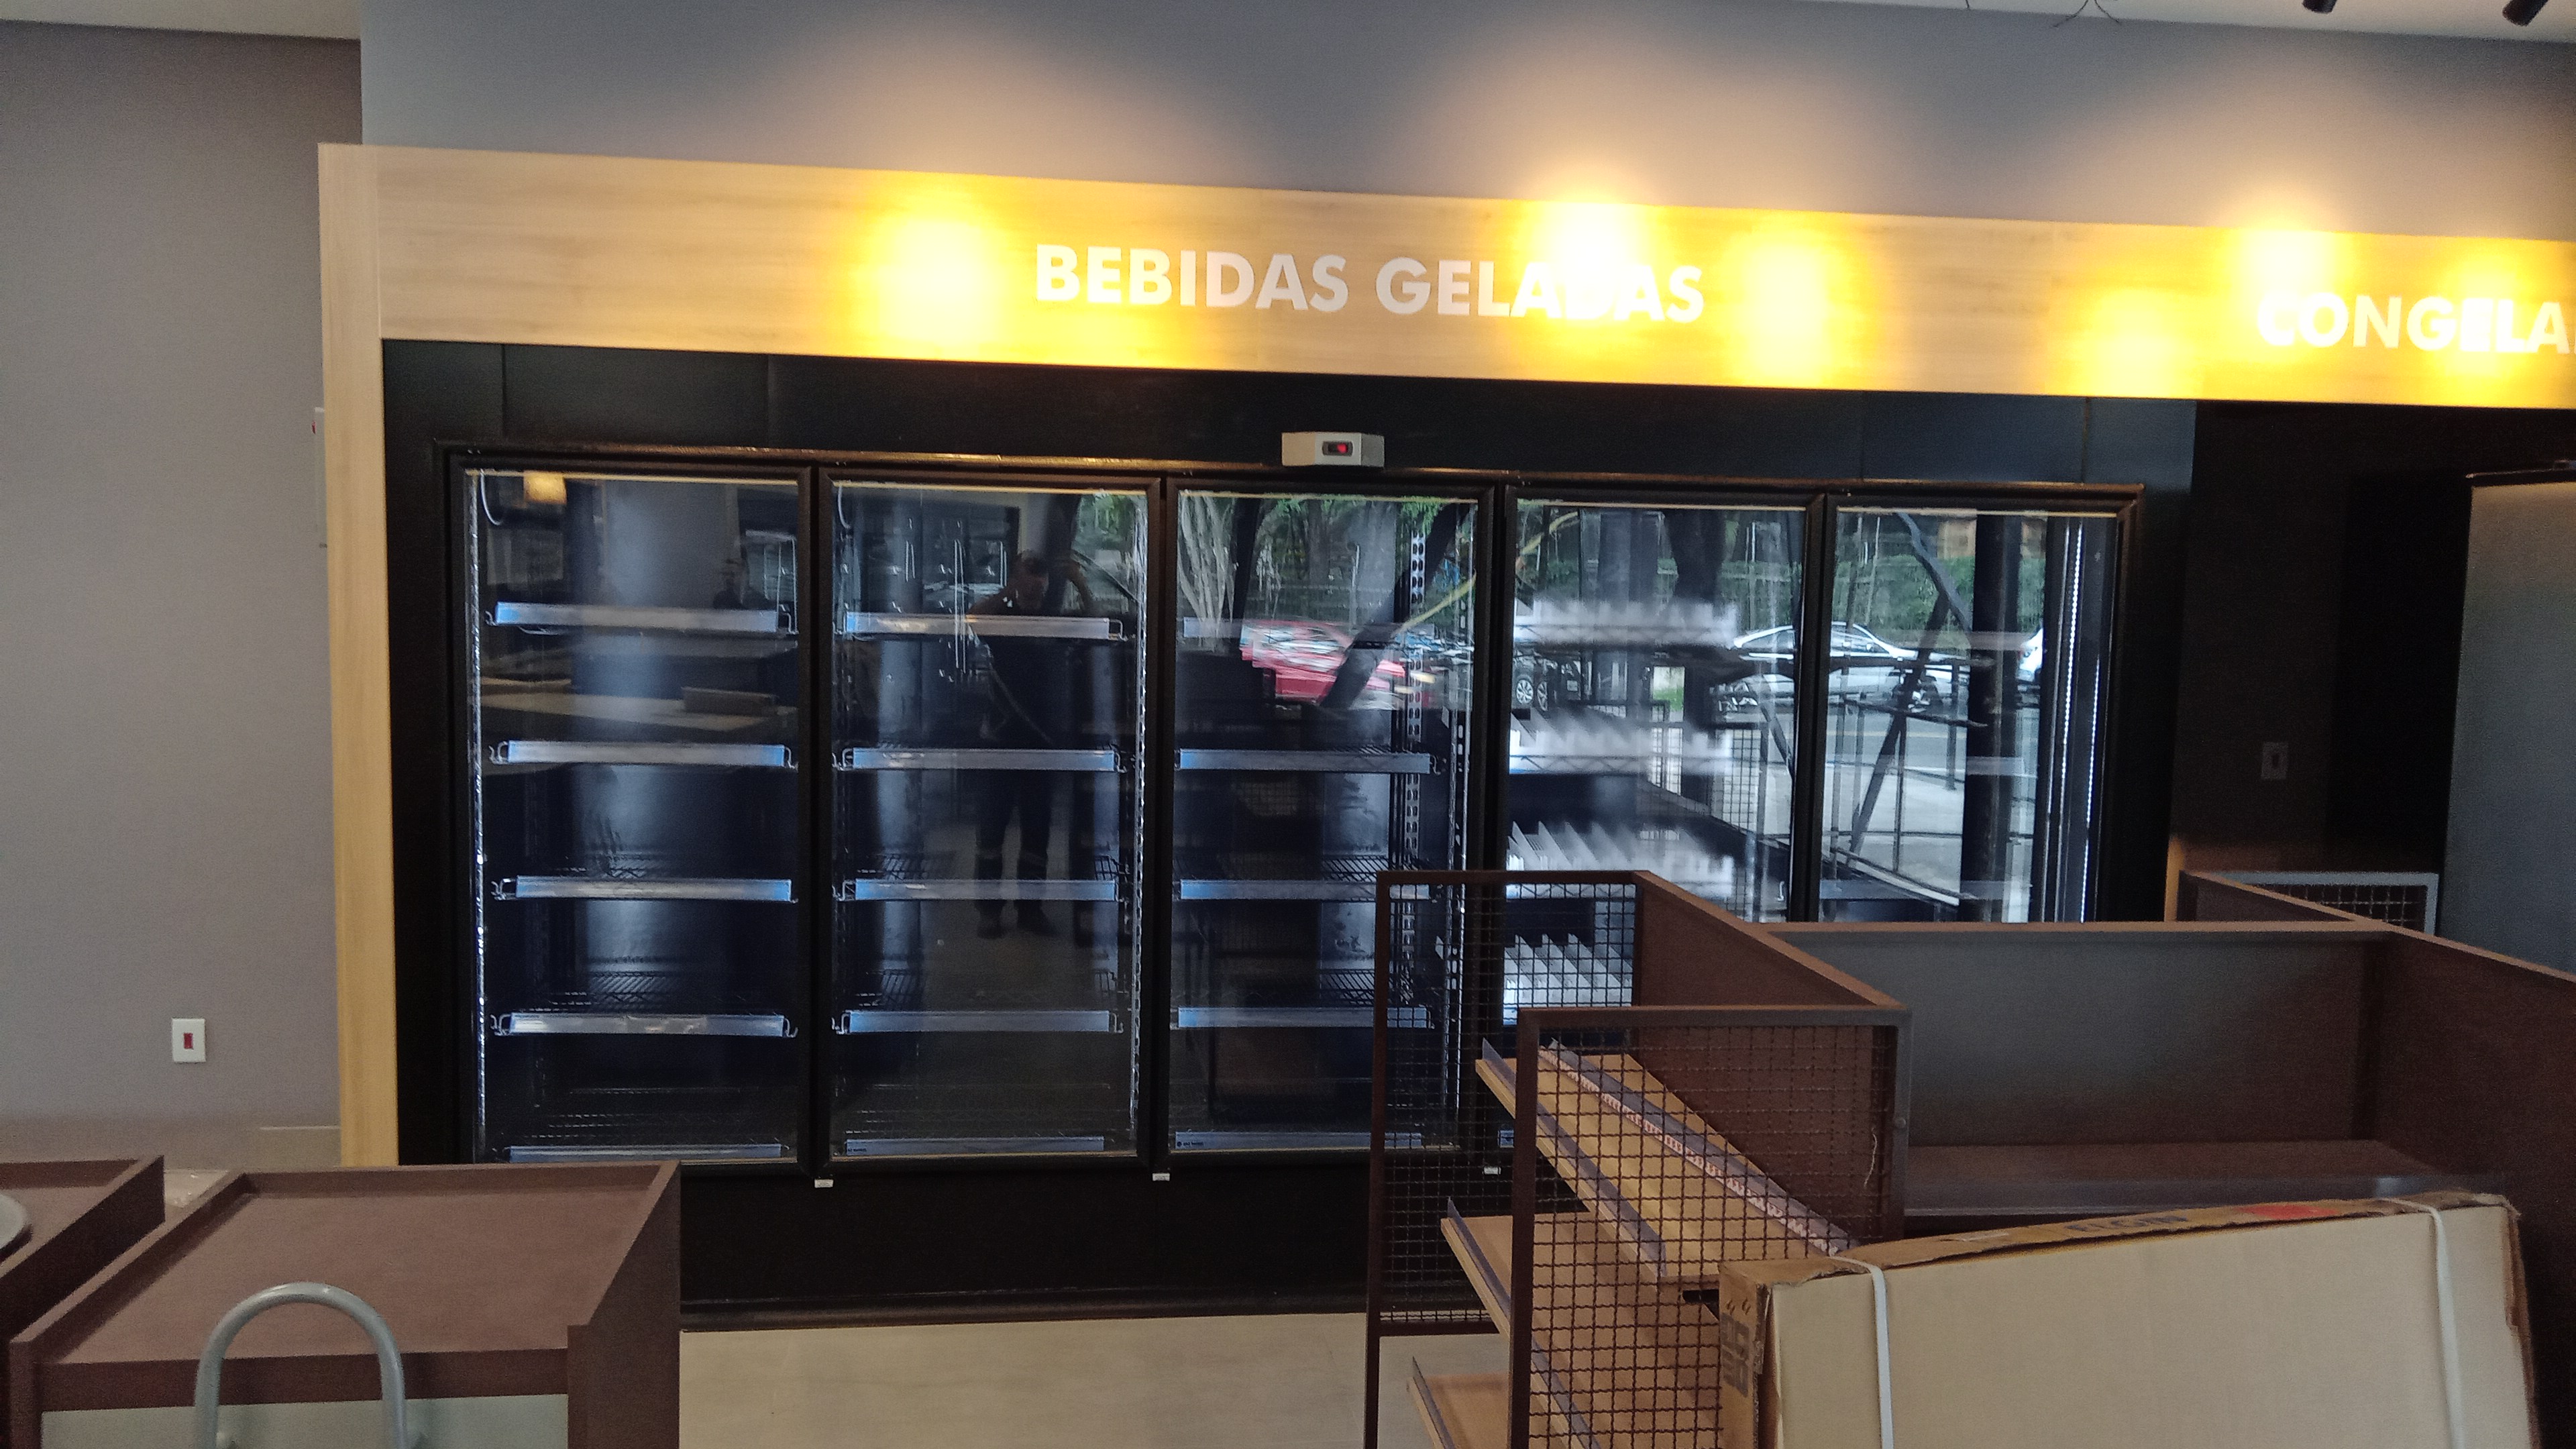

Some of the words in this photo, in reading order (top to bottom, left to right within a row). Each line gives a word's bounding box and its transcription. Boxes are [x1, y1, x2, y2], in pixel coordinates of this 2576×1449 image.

[1036, 244, 1349, 313] BEBIDAS
[1375, 257, 1705, 323] GELADAS
[2257, 292, 2576, 354] CONGELA
